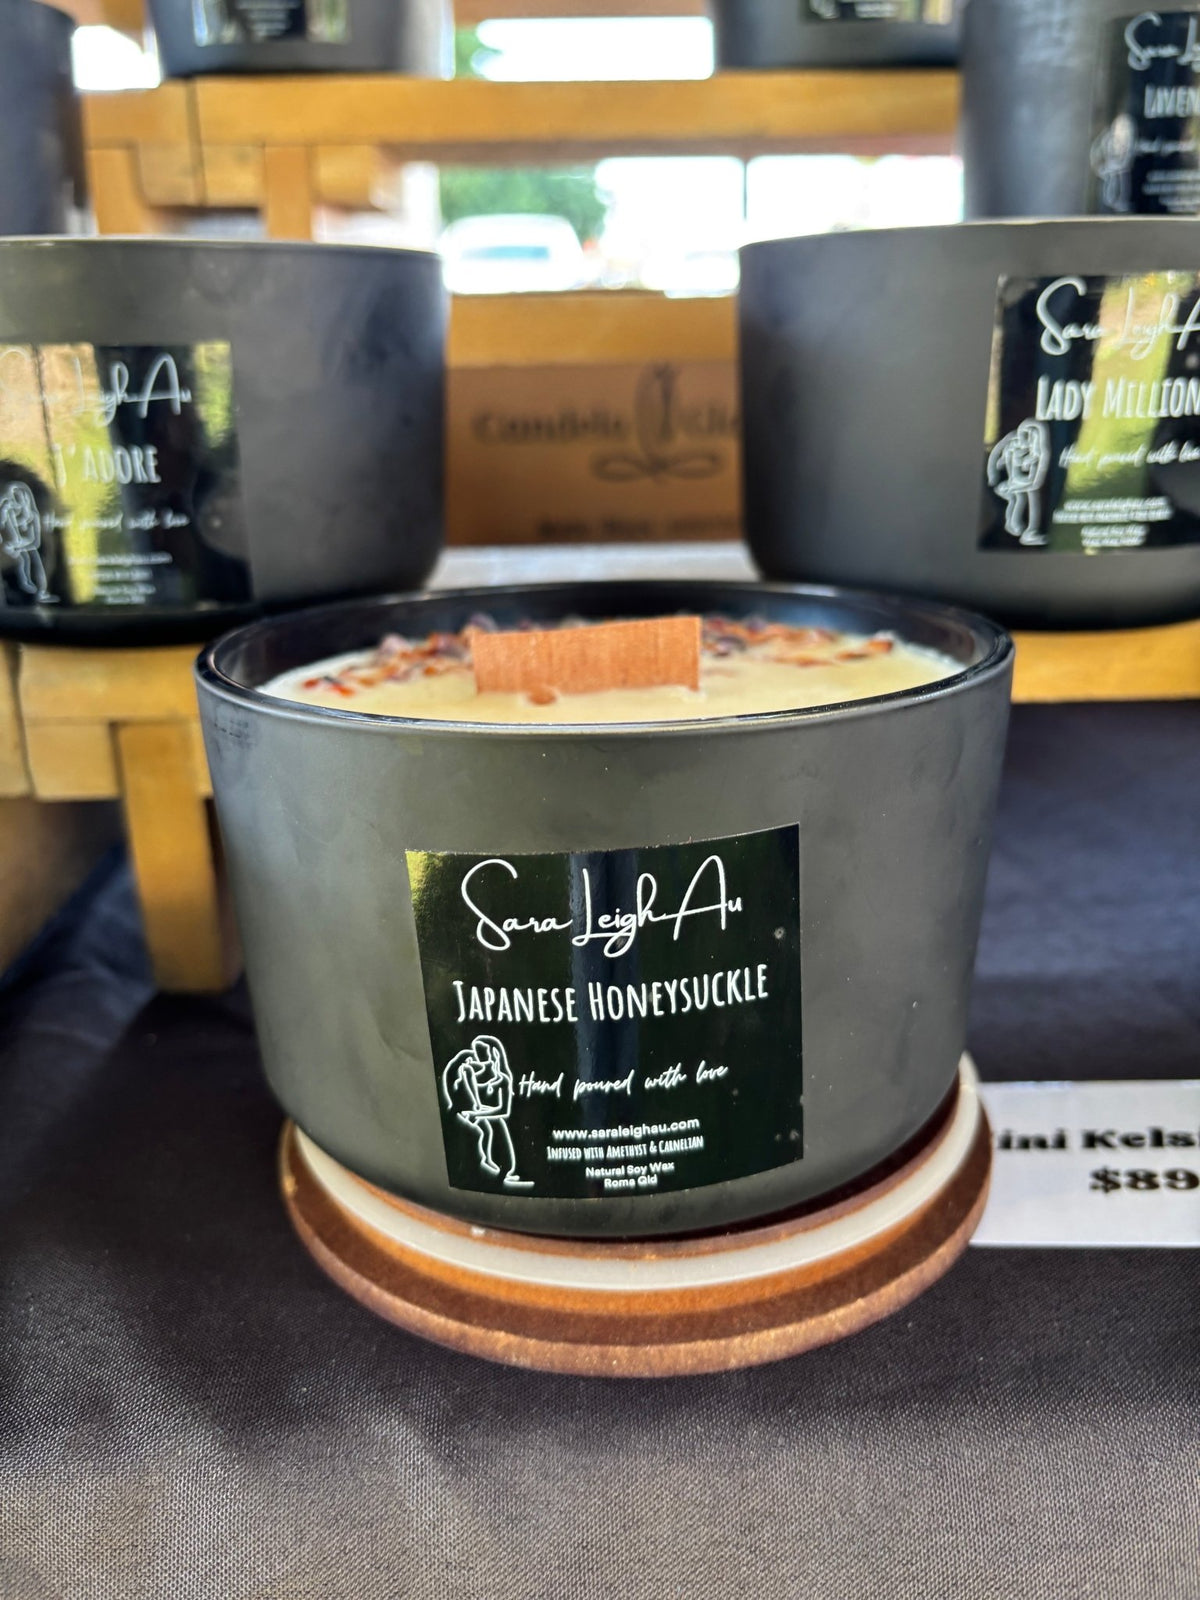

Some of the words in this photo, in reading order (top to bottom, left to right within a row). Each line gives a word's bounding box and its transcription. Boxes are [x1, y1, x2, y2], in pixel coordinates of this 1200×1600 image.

[1036, 276, 1108, 355] Sara
[1035, 374, 1096, 421] LADY
[51, 443, 161, 487] J'ADORE
[461, 858, 573, 951] Sara
[571, 868, 666, 958] Leigh
[660, 855, 743, 941] Au
[452, 979, 578, 1023] JAPANESE
[588, 963, 769, 1021] HONEYSUCKLE
[519, 1070, 564, 1099] Hand
[573, 1069, 635, 1102] poured
[644, 1062, 687, 1090] with
[696, 1059, 729, 1084] love
[547, 1145, 582, 1161] INFUSED
[583, 1145, 605, 1160] WITH
[606, 1142, 647, 1160] AMETHYST
[649, 1139, 657, 1154] &
[658, 1134, 705, 1154] CARNELIAN
[553, 1118, 700, 1138] www.saraleighau.com
[997, 1127, 1068, 1150] ini
[1081, 1125, 1200, 1150] Kels
[585, 1166, 625, 1179] Natural
[626, 1164, 648, 1178] Soy
[649, 1160, 675, 1173] Wax
[604, 1177, 636, 1189] Roma
[637, 1173, 658, 1187] Qld
